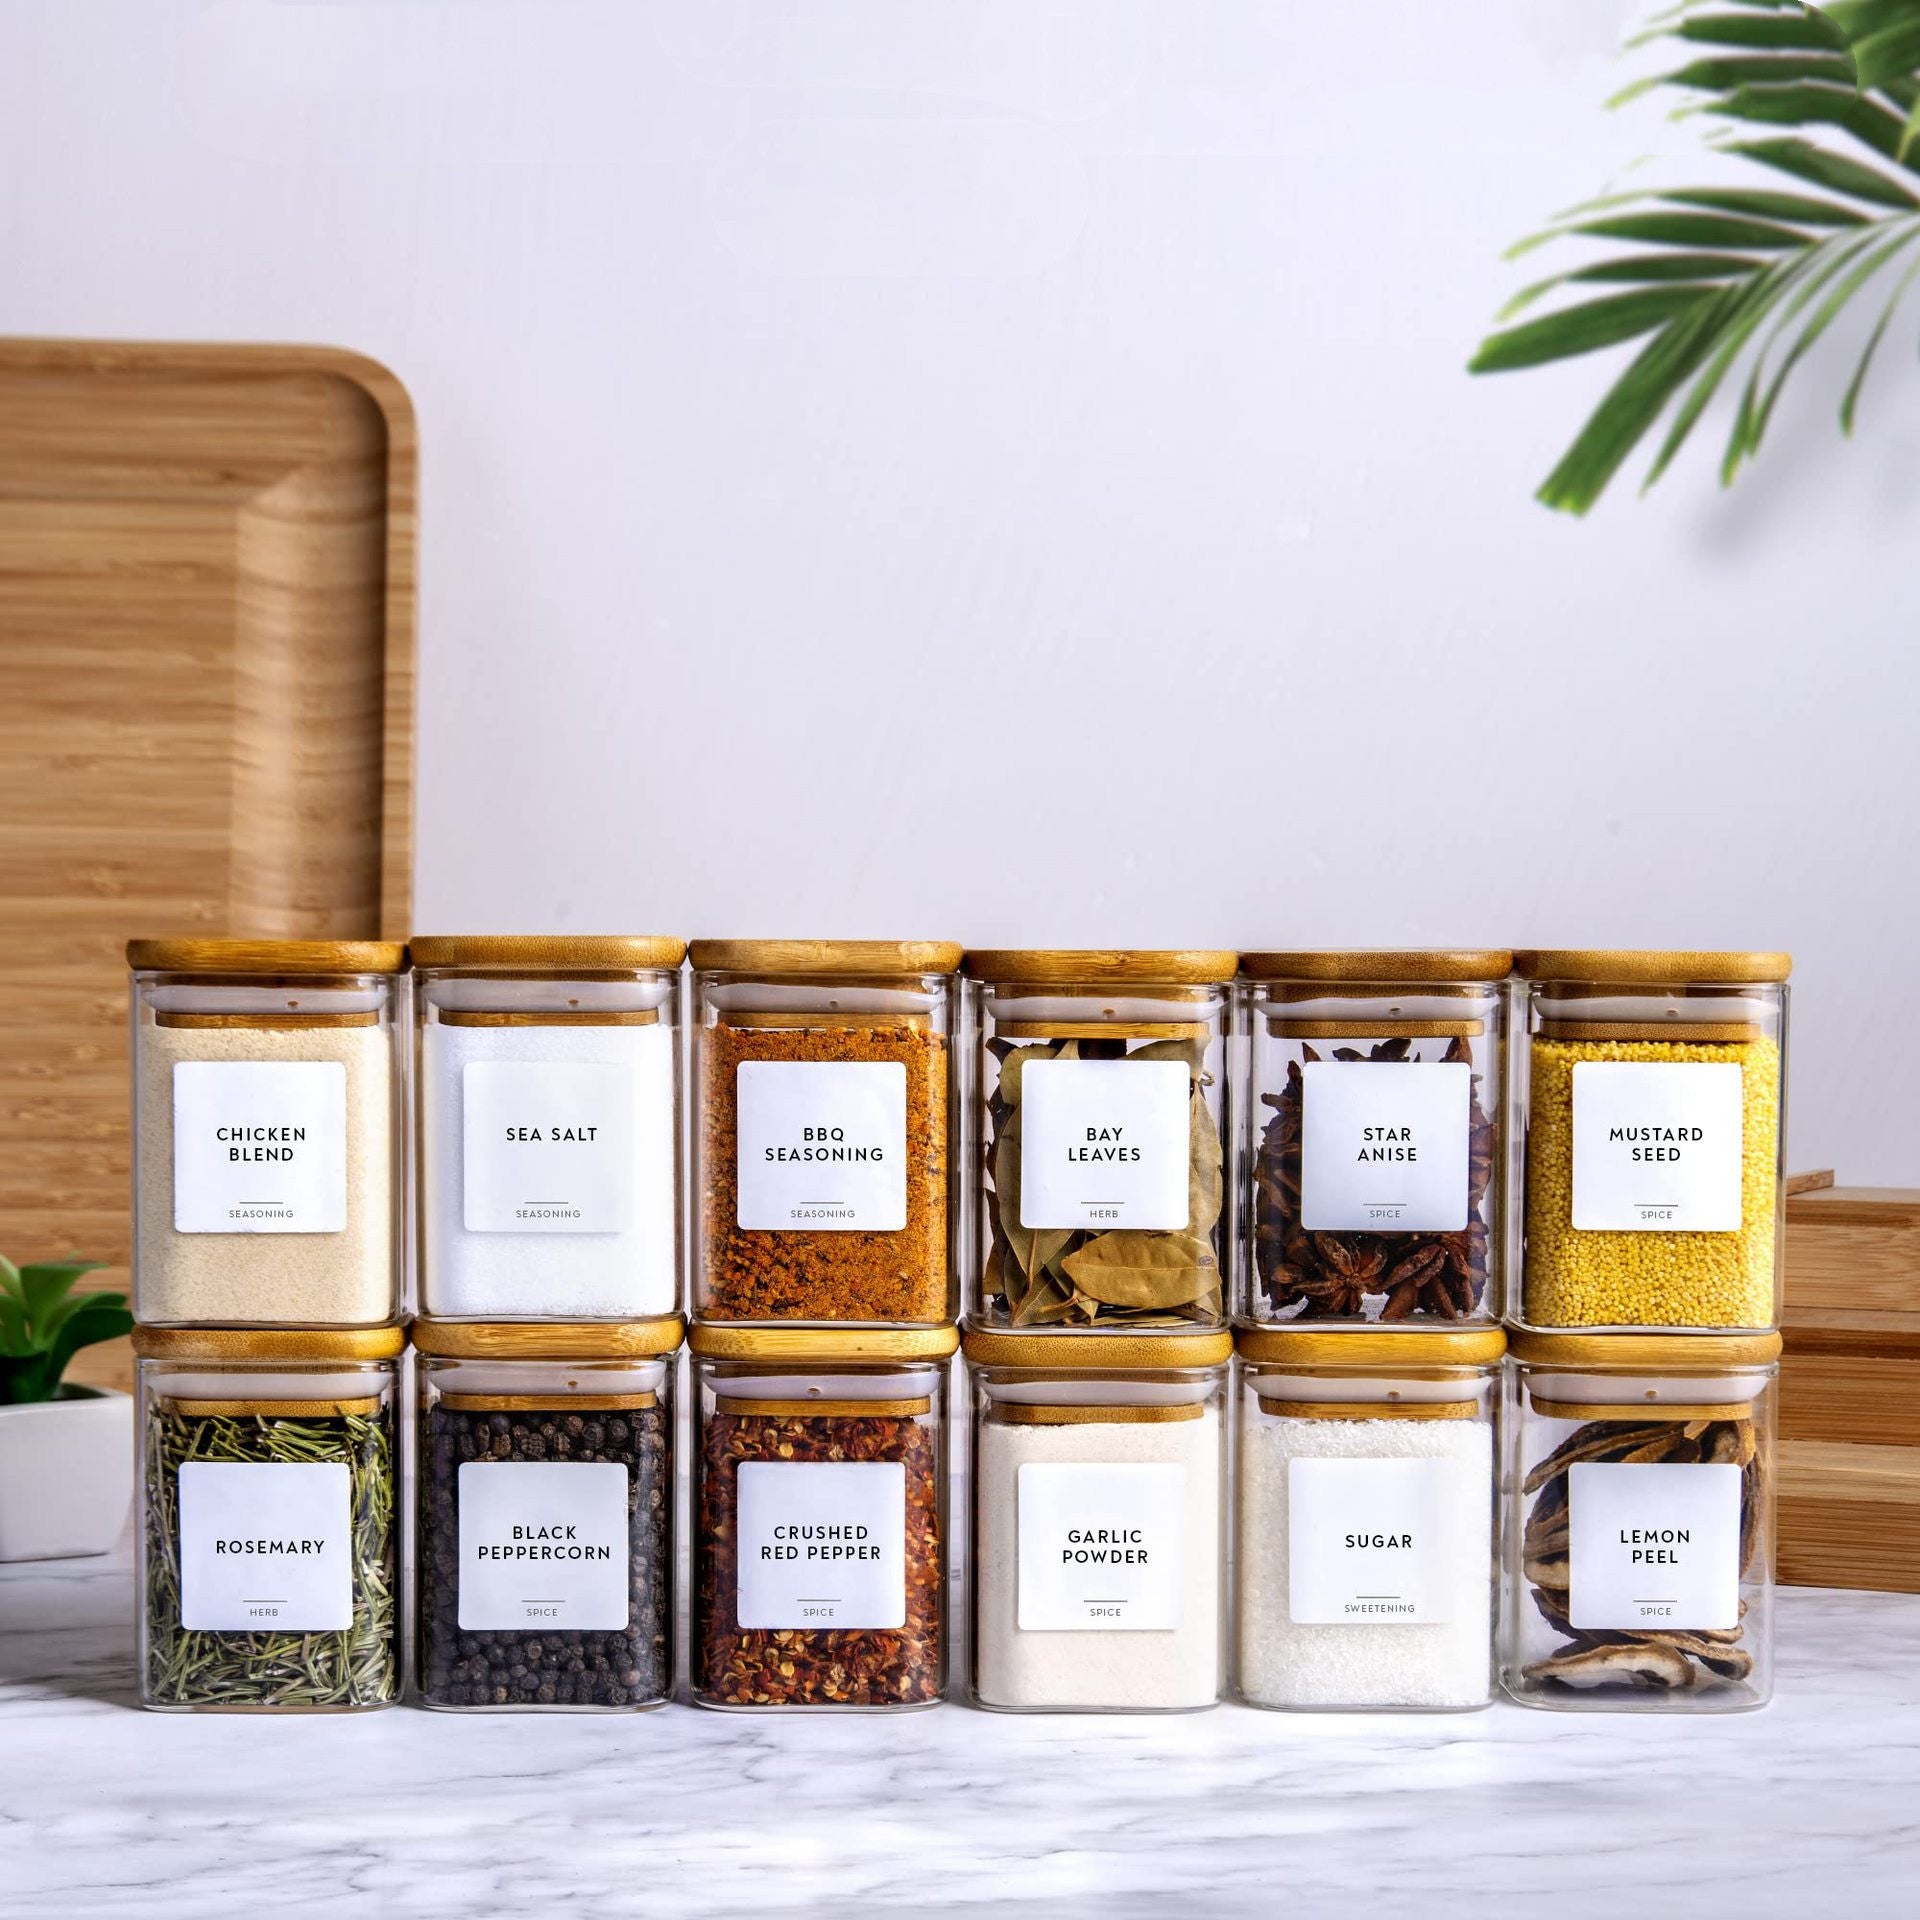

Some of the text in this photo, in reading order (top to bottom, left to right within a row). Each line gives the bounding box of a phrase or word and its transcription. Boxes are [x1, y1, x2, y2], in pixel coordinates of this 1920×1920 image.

[217, 1128, 305, 1141] CHICKEN
[507, 1128, 597, 1141] SEA SALT
[804, 1128, 844, 1142] BBQ
[1087, 1128, 1123, 1141] BAY
[1364, 1128, 1411, 1141] STAR
[1609, 1128, 1703, 1141] MUSTARD
[230, 1148, 293, 1161] BLEND
[765, 1148, 883, 1161] SEASONING
[1069, 1148, 1140, 1161] LEAVES
[1357, 1148, 1417, 1161] ANISE
[1632, 1148, 1680, 1161] SEED
[228, 1209, 294, 1219] SEASONING
[515, 1209, 581, 1219] SEASONING
[790, 1209, 856, 1219] SEASONING
[1089, 1209, 1119, 1219] HERB
[1368, 1208, 1402, 1219] SPICE
[1640, 1209, 1674, 1220] SPICE
[513, 1526, 576, 1539] BLACK
[774, 1526, 867, 1539] CRUSHED
[1068, 1530, 1142, 1543] GARLIC
[1621, 1530, 1689, 1543] LEMON
[217, 1540, 324, 1554] ROSEMARY
[1345, 1535, 1411, 1548] SUGAR
[479, 1546, 609, 1559] PEPPERCORN
[761, 1546, 880, 1559] RED PEPPER
[1063, 1550, 1148, 1563] POWDER
[1632, 1550, 1678, 1563] PEEL
[249, 1608, 279, 1617] HERB
[526, 1608, 558, 1617] SPICE
[802, 1607, 835, 1617] SPICE
[1089, 1608, 1122, 1617] SPICE
[1344, 1604, 1415, 1613] SWEETENING
[1639, 1607, 1672, 1616] SPICE
